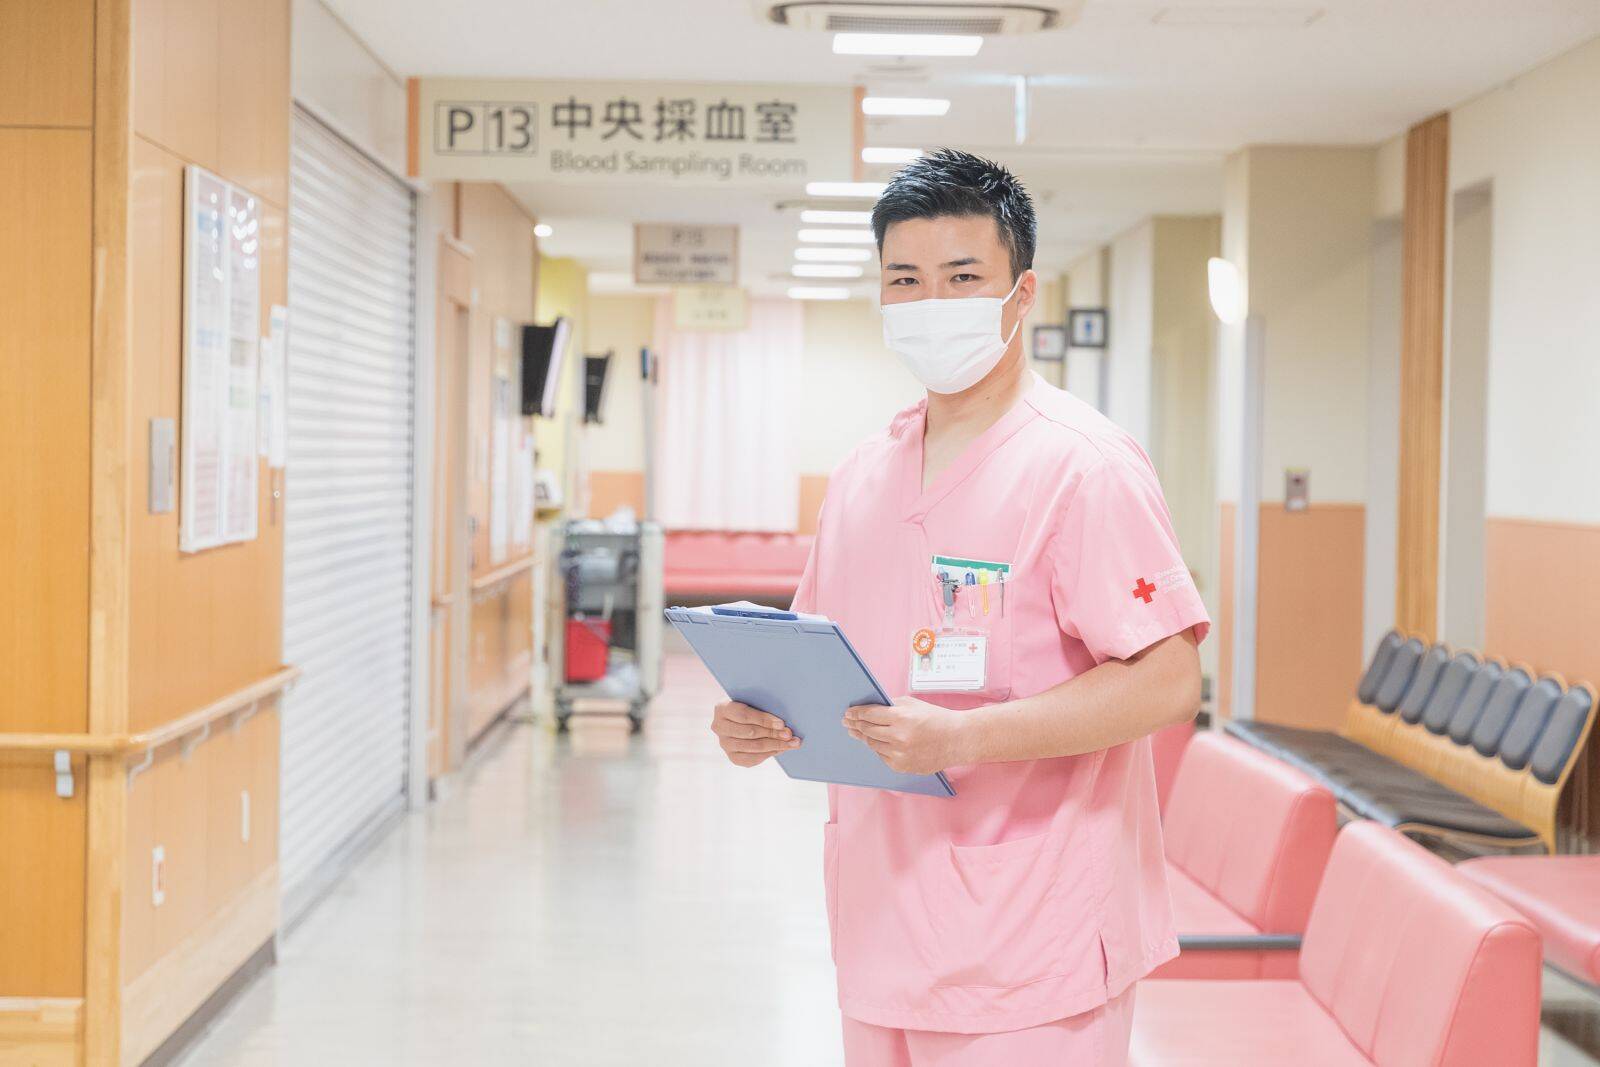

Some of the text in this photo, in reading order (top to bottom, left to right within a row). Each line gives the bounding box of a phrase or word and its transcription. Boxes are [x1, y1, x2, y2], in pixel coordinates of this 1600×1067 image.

[448, 108, 531, 150] P 13
[551, 95, 797, 141] 中央採血室
[550, 151, 807, 180] Blood Sampling Room
